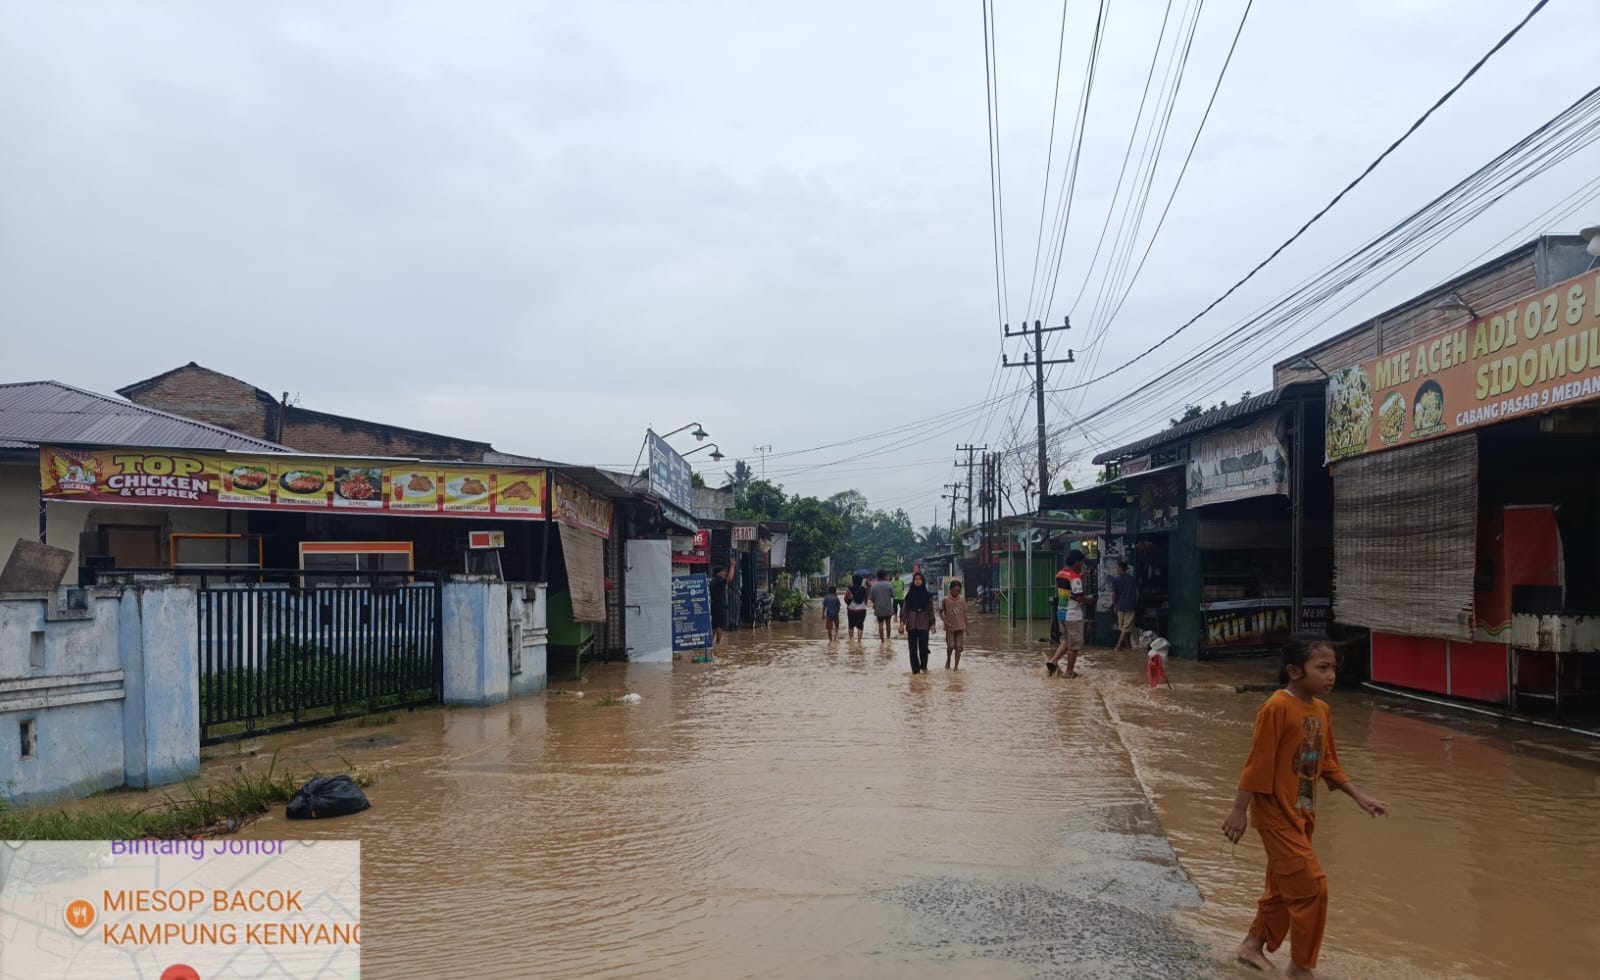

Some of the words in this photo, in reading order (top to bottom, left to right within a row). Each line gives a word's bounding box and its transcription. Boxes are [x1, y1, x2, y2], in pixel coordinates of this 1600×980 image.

[1375, 350, 1411, 391] MIE
[1414, 328, 1468, 379] ACEH
[1472, 308, 1519, 359] ADI
[1565, 284, 1587, 326] &
[1476, 327, 1600, 401] SIDOMUL
[1456, 404, 1499, 426] CABANG
[1500, 392, 1538, 416] PASAR
[1541, 391, 1549, 406] 9
[1552, 376, 1600, 403] MEDAN
[114, 455, 204, 476] TOP
[60, 483, 91, 491] CHICKEN
[108, 474, 208, 493] CHICKEN
[120, 488, 132, 497] &
[135, 488, 200, 500] GEPREK
